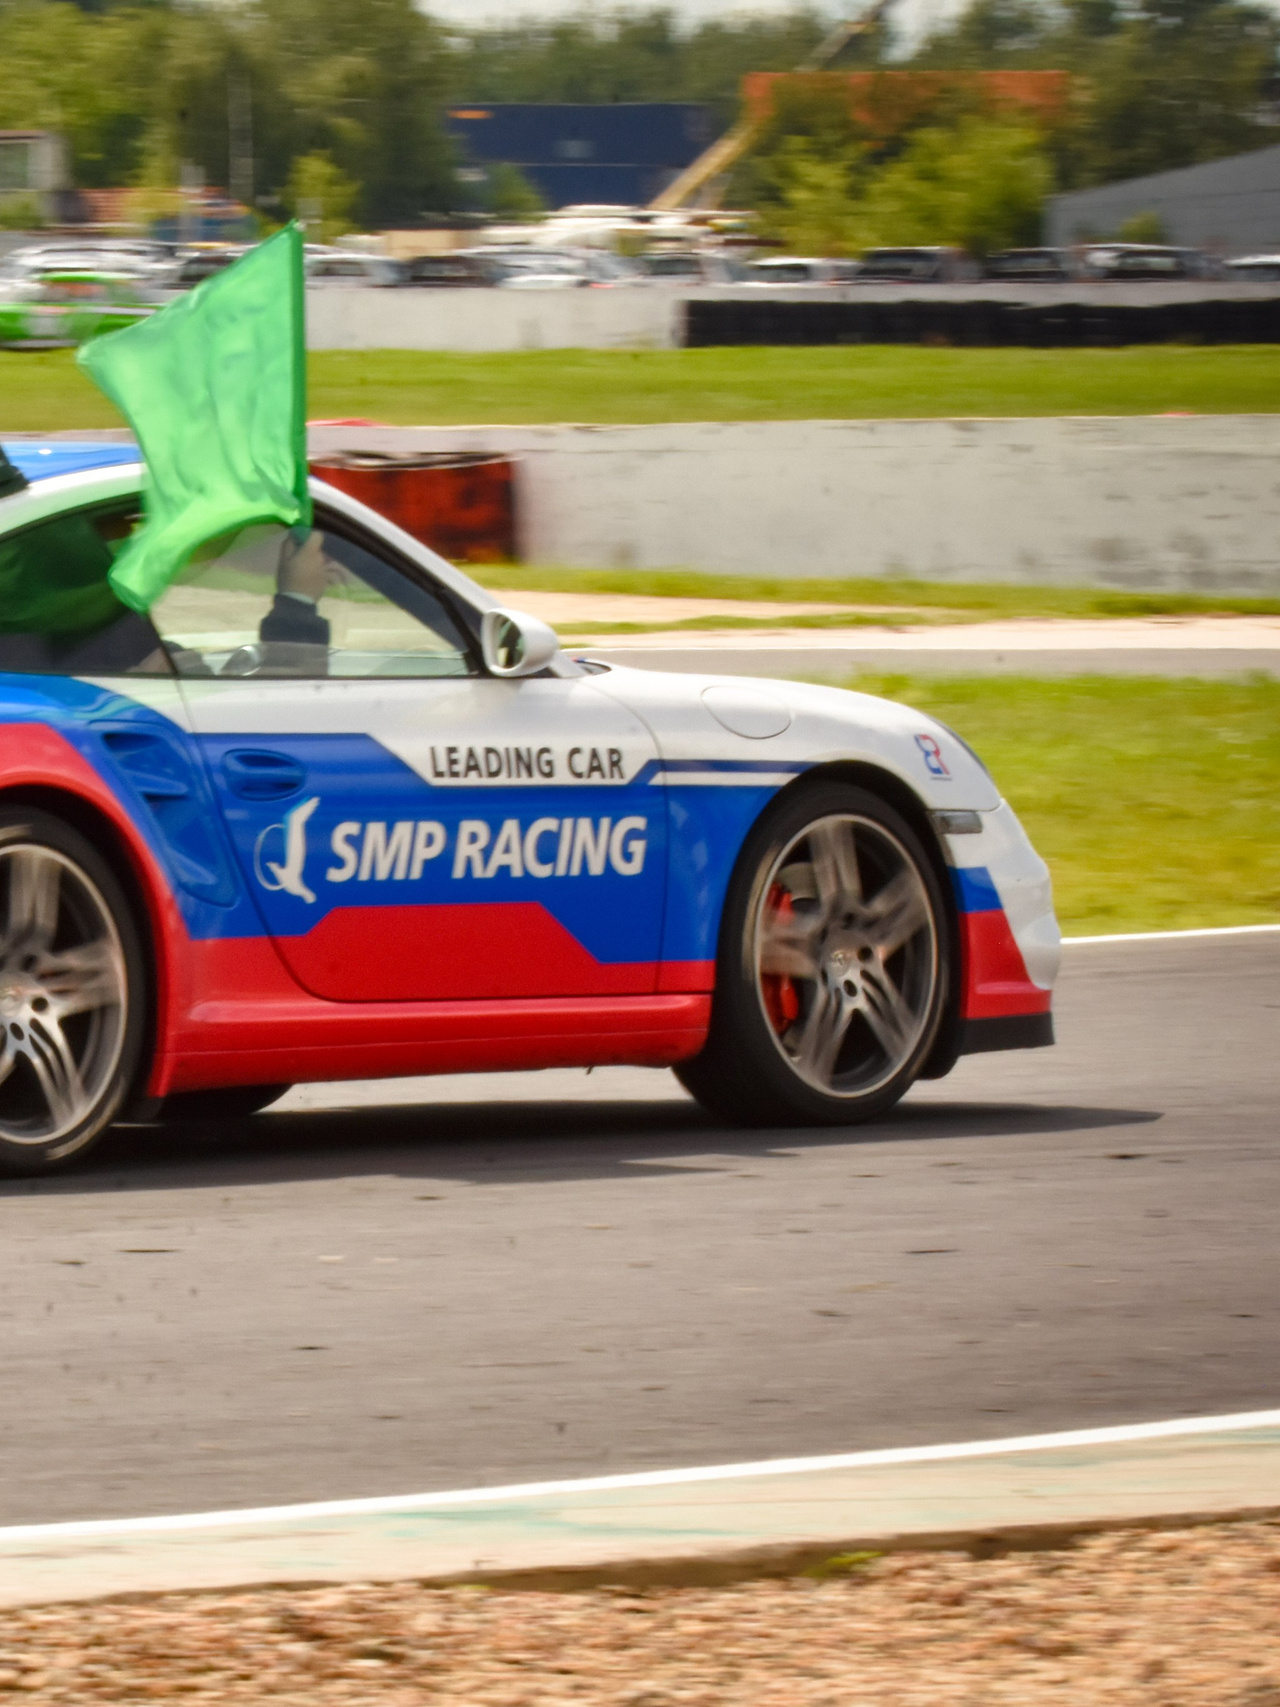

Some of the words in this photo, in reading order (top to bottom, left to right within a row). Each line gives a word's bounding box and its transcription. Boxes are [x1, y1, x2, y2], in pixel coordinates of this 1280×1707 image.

[429, 746, 555, 779] LEADING
[566, 747, 627, 779] CAR
[325, 820, 447, 883] SMP
[451, 816, 648, 879] RACING
